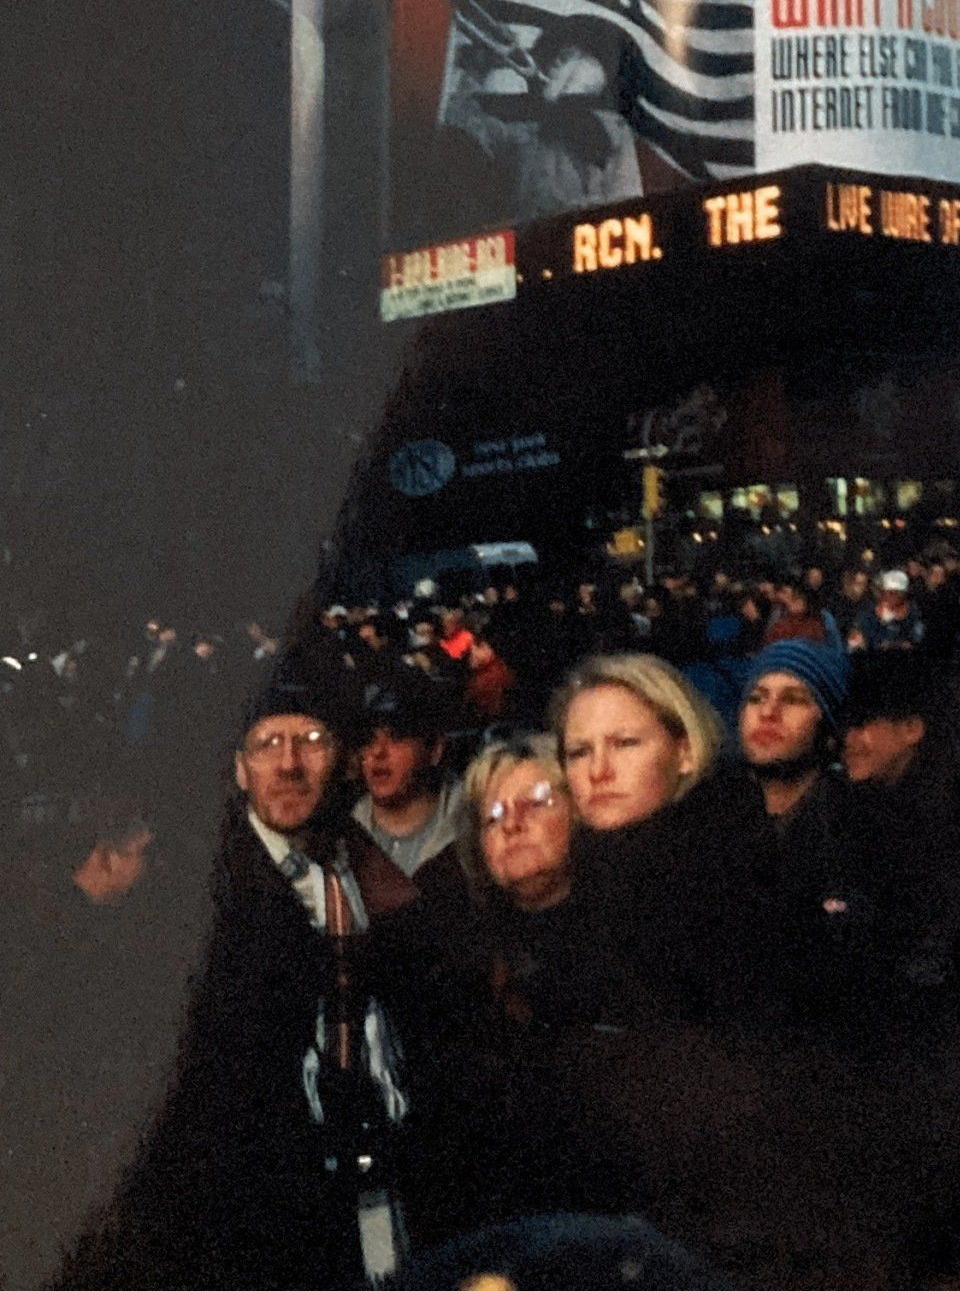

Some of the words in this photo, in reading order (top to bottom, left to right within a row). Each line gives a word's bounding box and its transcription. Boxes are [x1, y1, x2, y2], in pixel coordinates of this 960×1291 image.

[769, 36, 851, 83] WHERE
[857, 36, 898, 80] ELSE
[769, 86, 876, 134] INTERNET
[572, 212, 664, 275] RCN.
[704, 183, 783, 248] THE
[825, 181, 873, 235] LIVE
